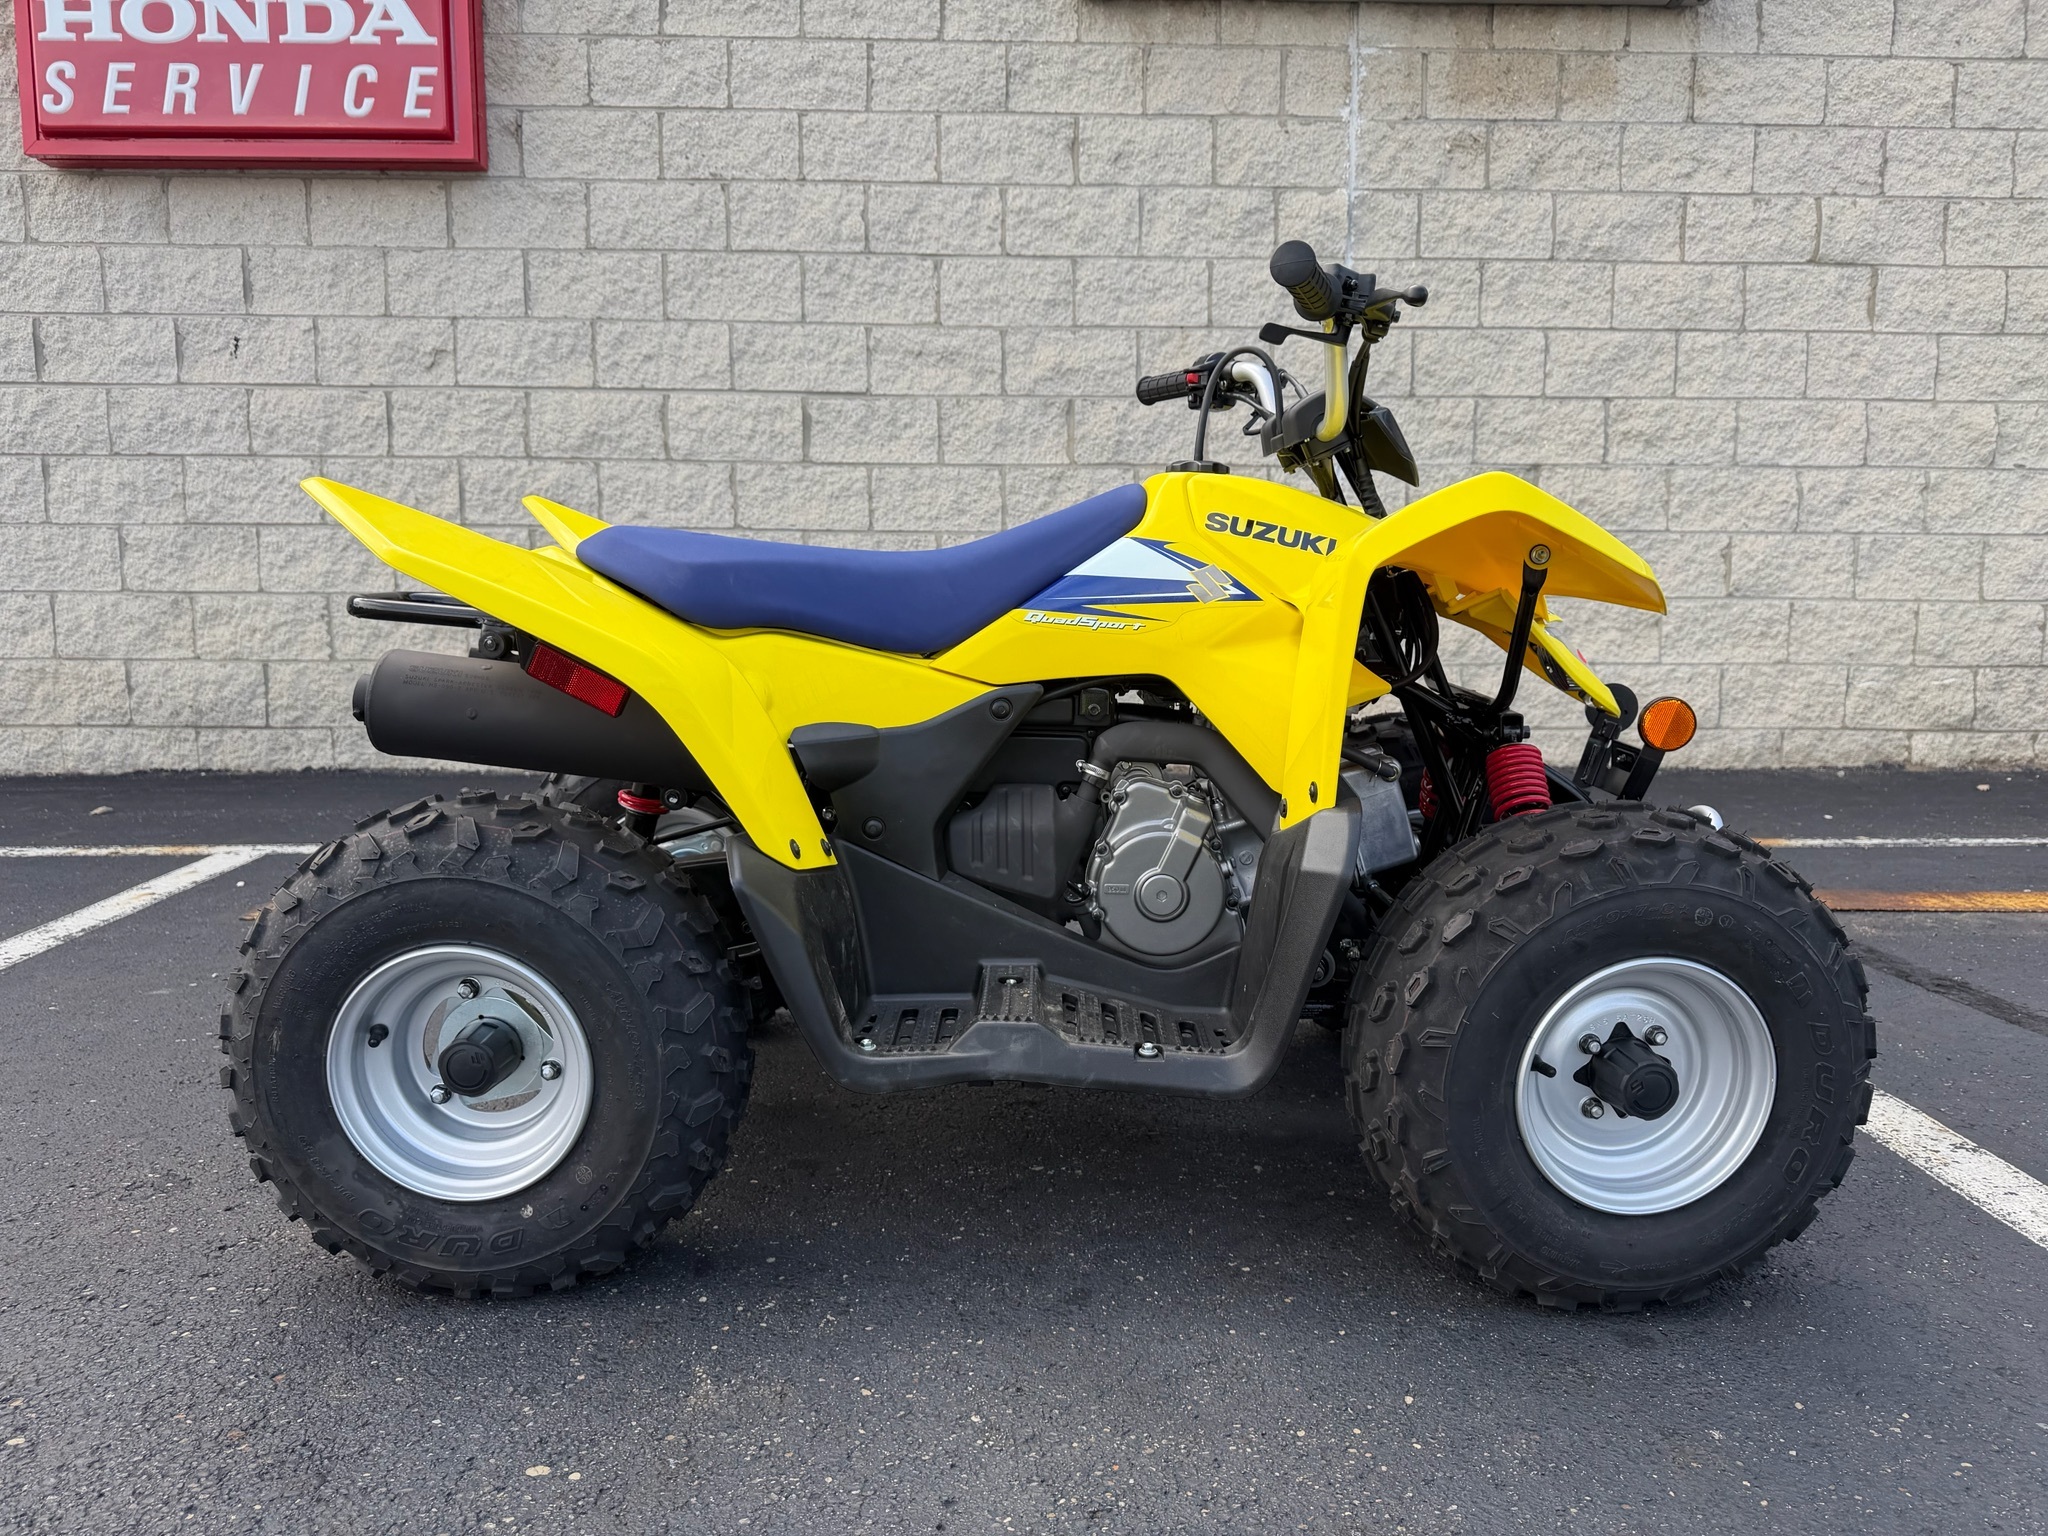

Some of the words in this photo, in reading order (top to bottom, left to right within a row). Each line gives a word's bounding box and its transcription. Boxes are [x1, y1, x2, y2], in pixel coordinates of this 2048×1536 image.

[37, 0, 438, 45] HONDA
[42, 60, 439, 119] SERVICE
[1204, 511, 1338, 557] SUZUKI
[1024, 611, 1147, 631] QuadSport
[1782, 1020, 1836, 1185] DURO
[356, 1207, 525, 1257] DURO
